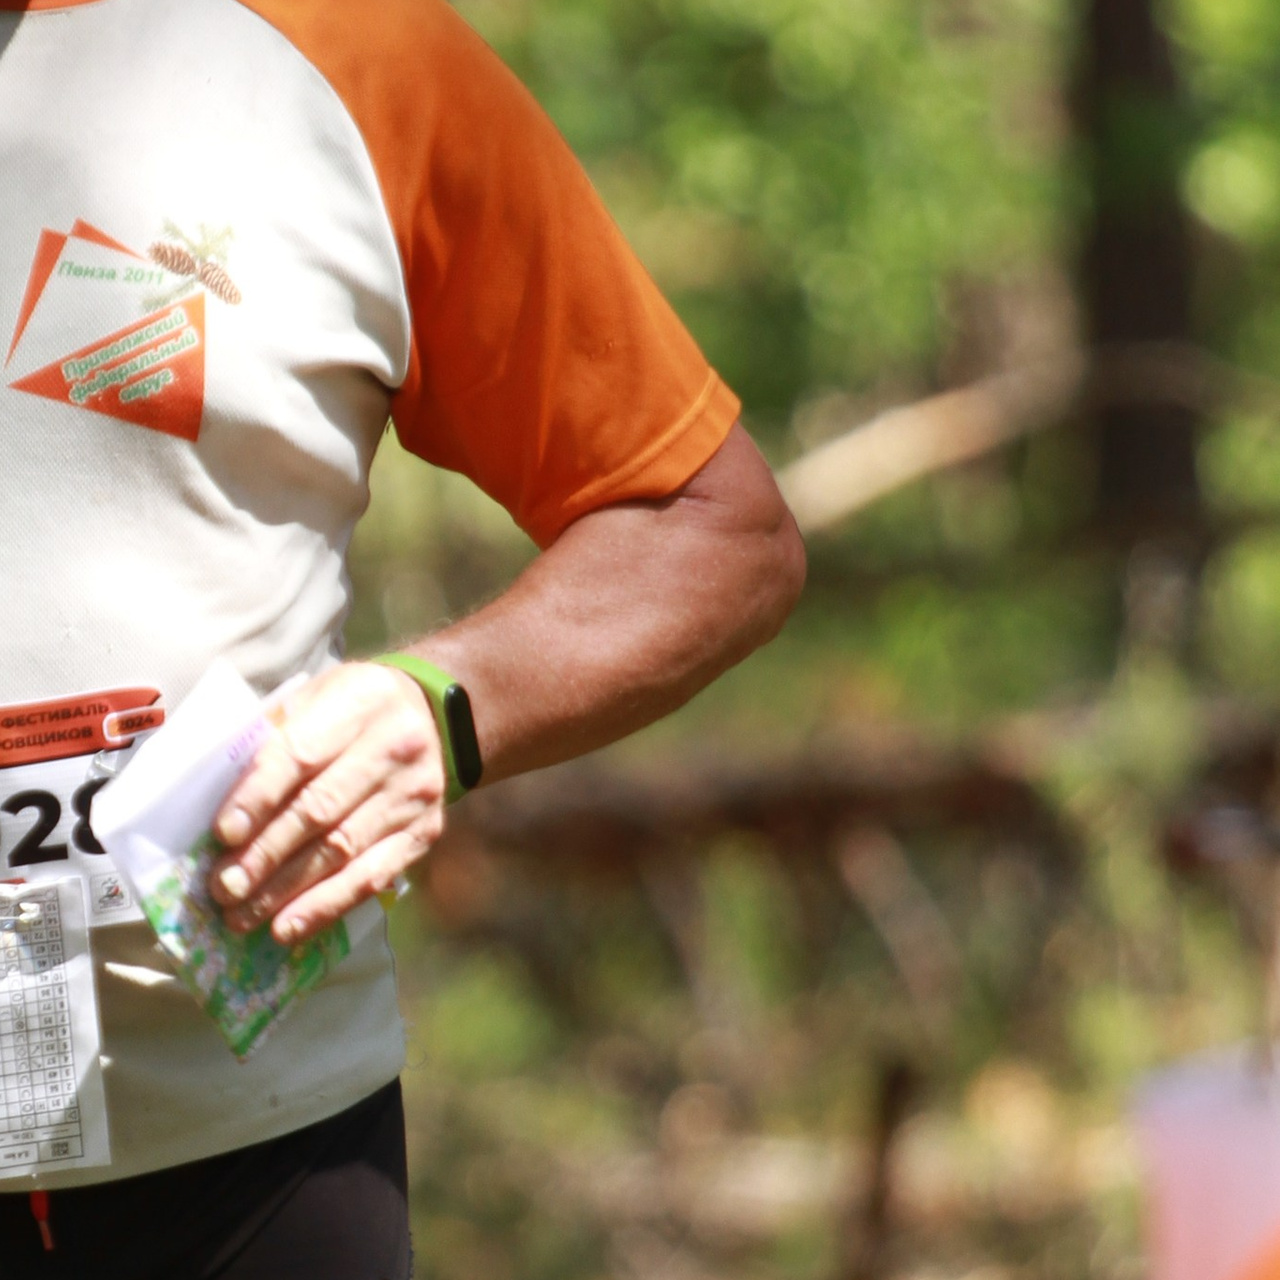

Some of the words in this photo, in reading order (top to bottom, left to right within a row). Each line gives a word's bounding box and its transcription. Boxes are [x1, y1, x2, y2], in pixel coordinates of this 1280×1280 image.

[58, 260, 116, 281] Пенза
[122, 267, 165, 286] 2011
[62, 310, 184, 381] Приволжский
[70, 330, 196, 402] федеральный
[0, 703, 109, 729] ФЕСТИВАЛЬ
